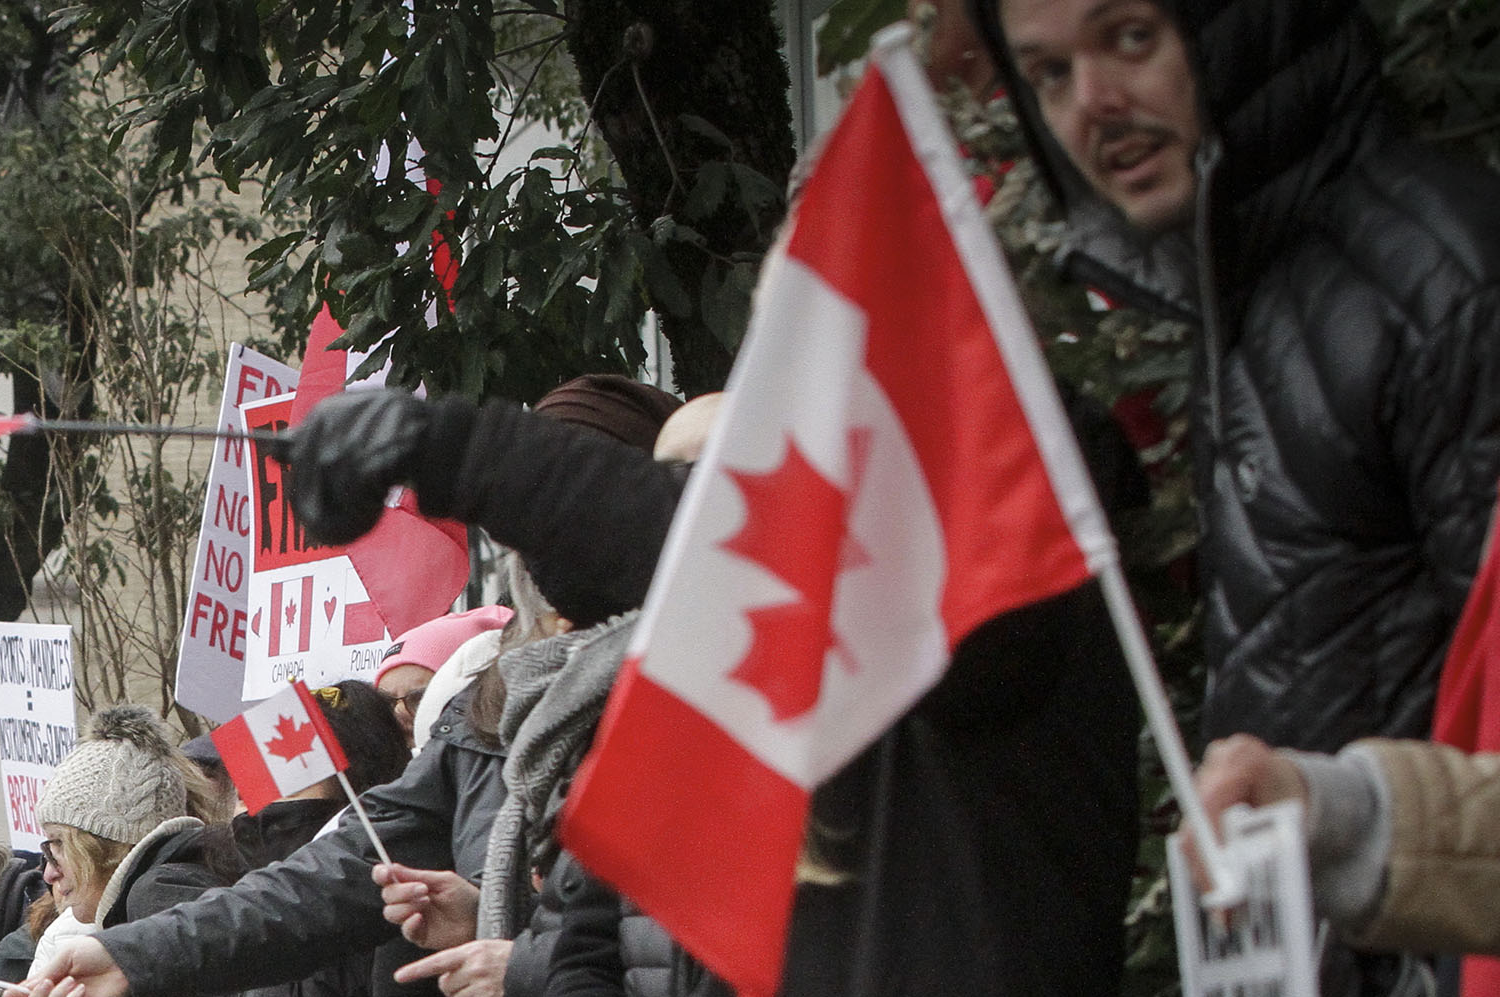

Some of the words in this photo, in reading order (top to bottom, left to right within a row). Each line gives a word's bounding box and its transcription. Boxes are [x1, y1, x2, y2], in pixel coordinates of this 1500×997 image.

[203, 539, 244, 593] NO
[190, 592, 247, 662] FRE
[272, 658, 304, 683] CANADA
